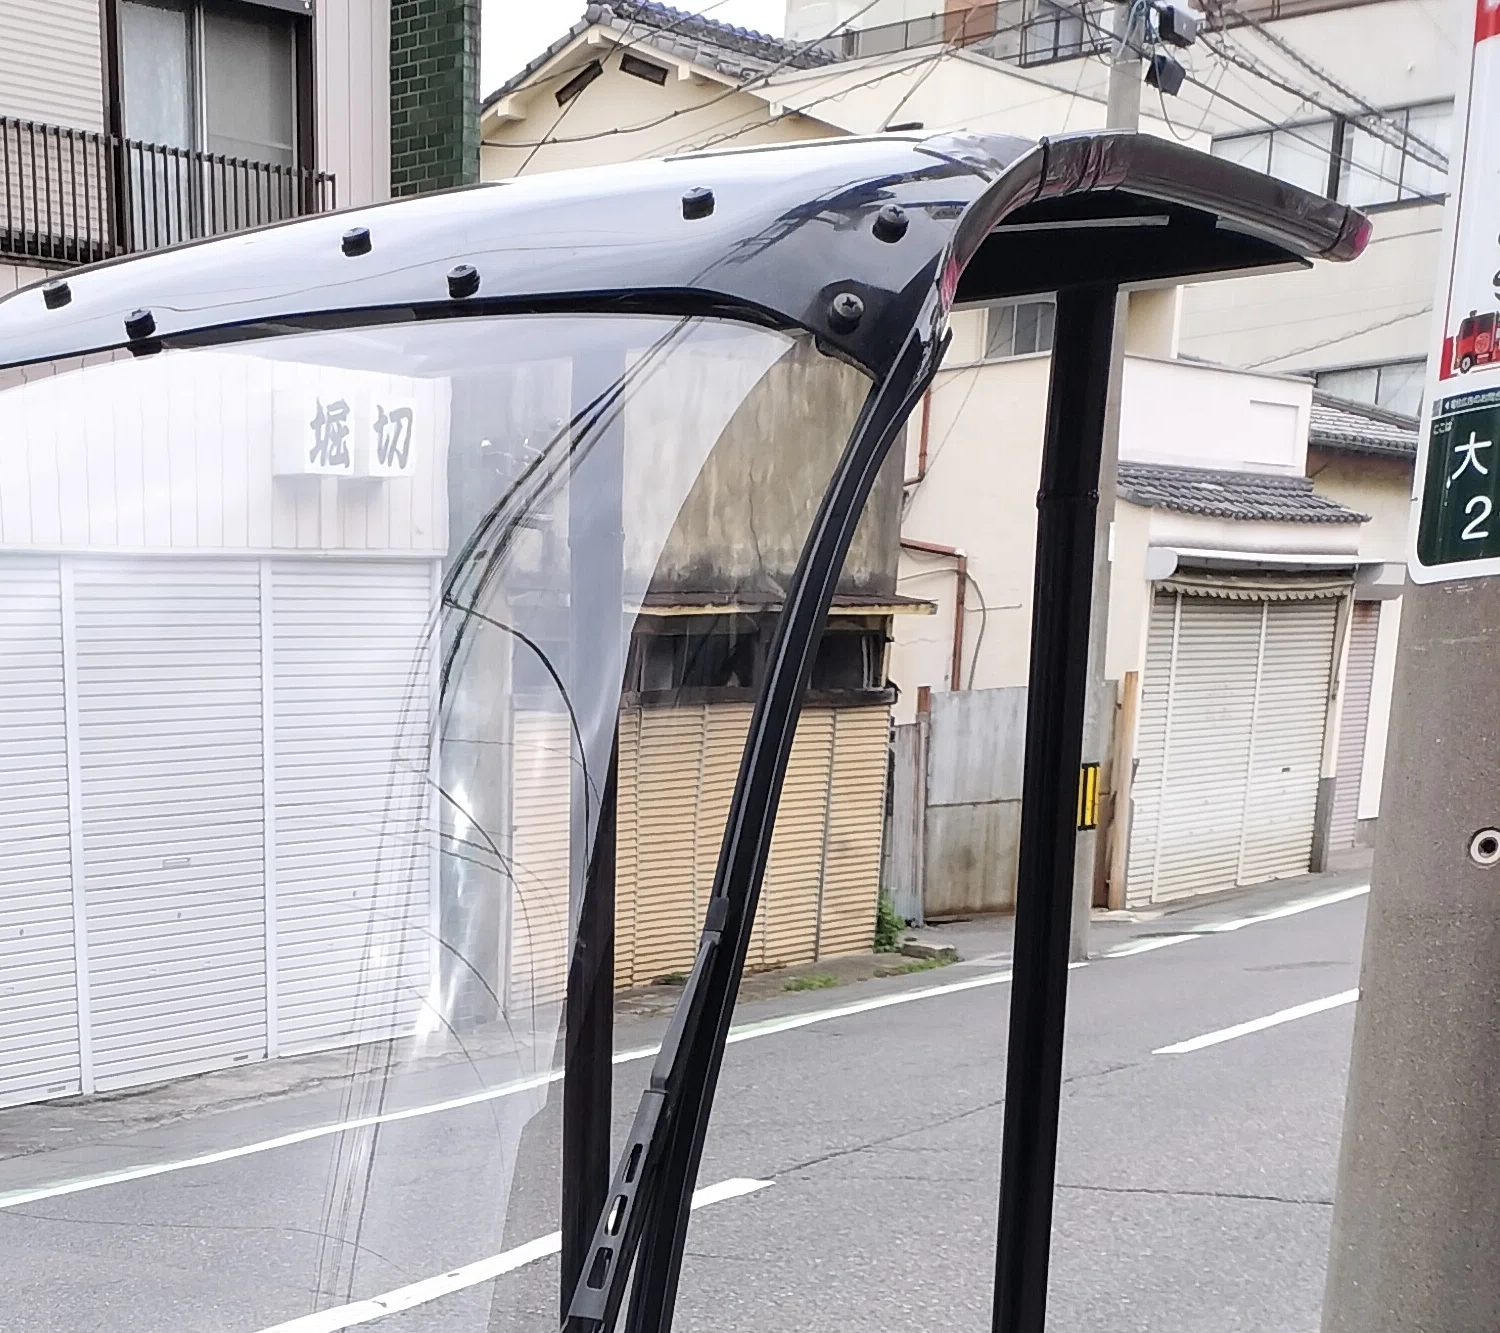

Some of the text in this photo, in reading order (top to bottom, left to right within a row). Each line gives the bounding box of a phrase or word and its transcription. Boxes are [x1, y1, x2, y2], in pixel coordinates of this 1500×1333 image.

[309, 396, 414, 470] 堀切
[1454, 431, 1492, 480] 大
[1461, 495, 1492, 540] 2
